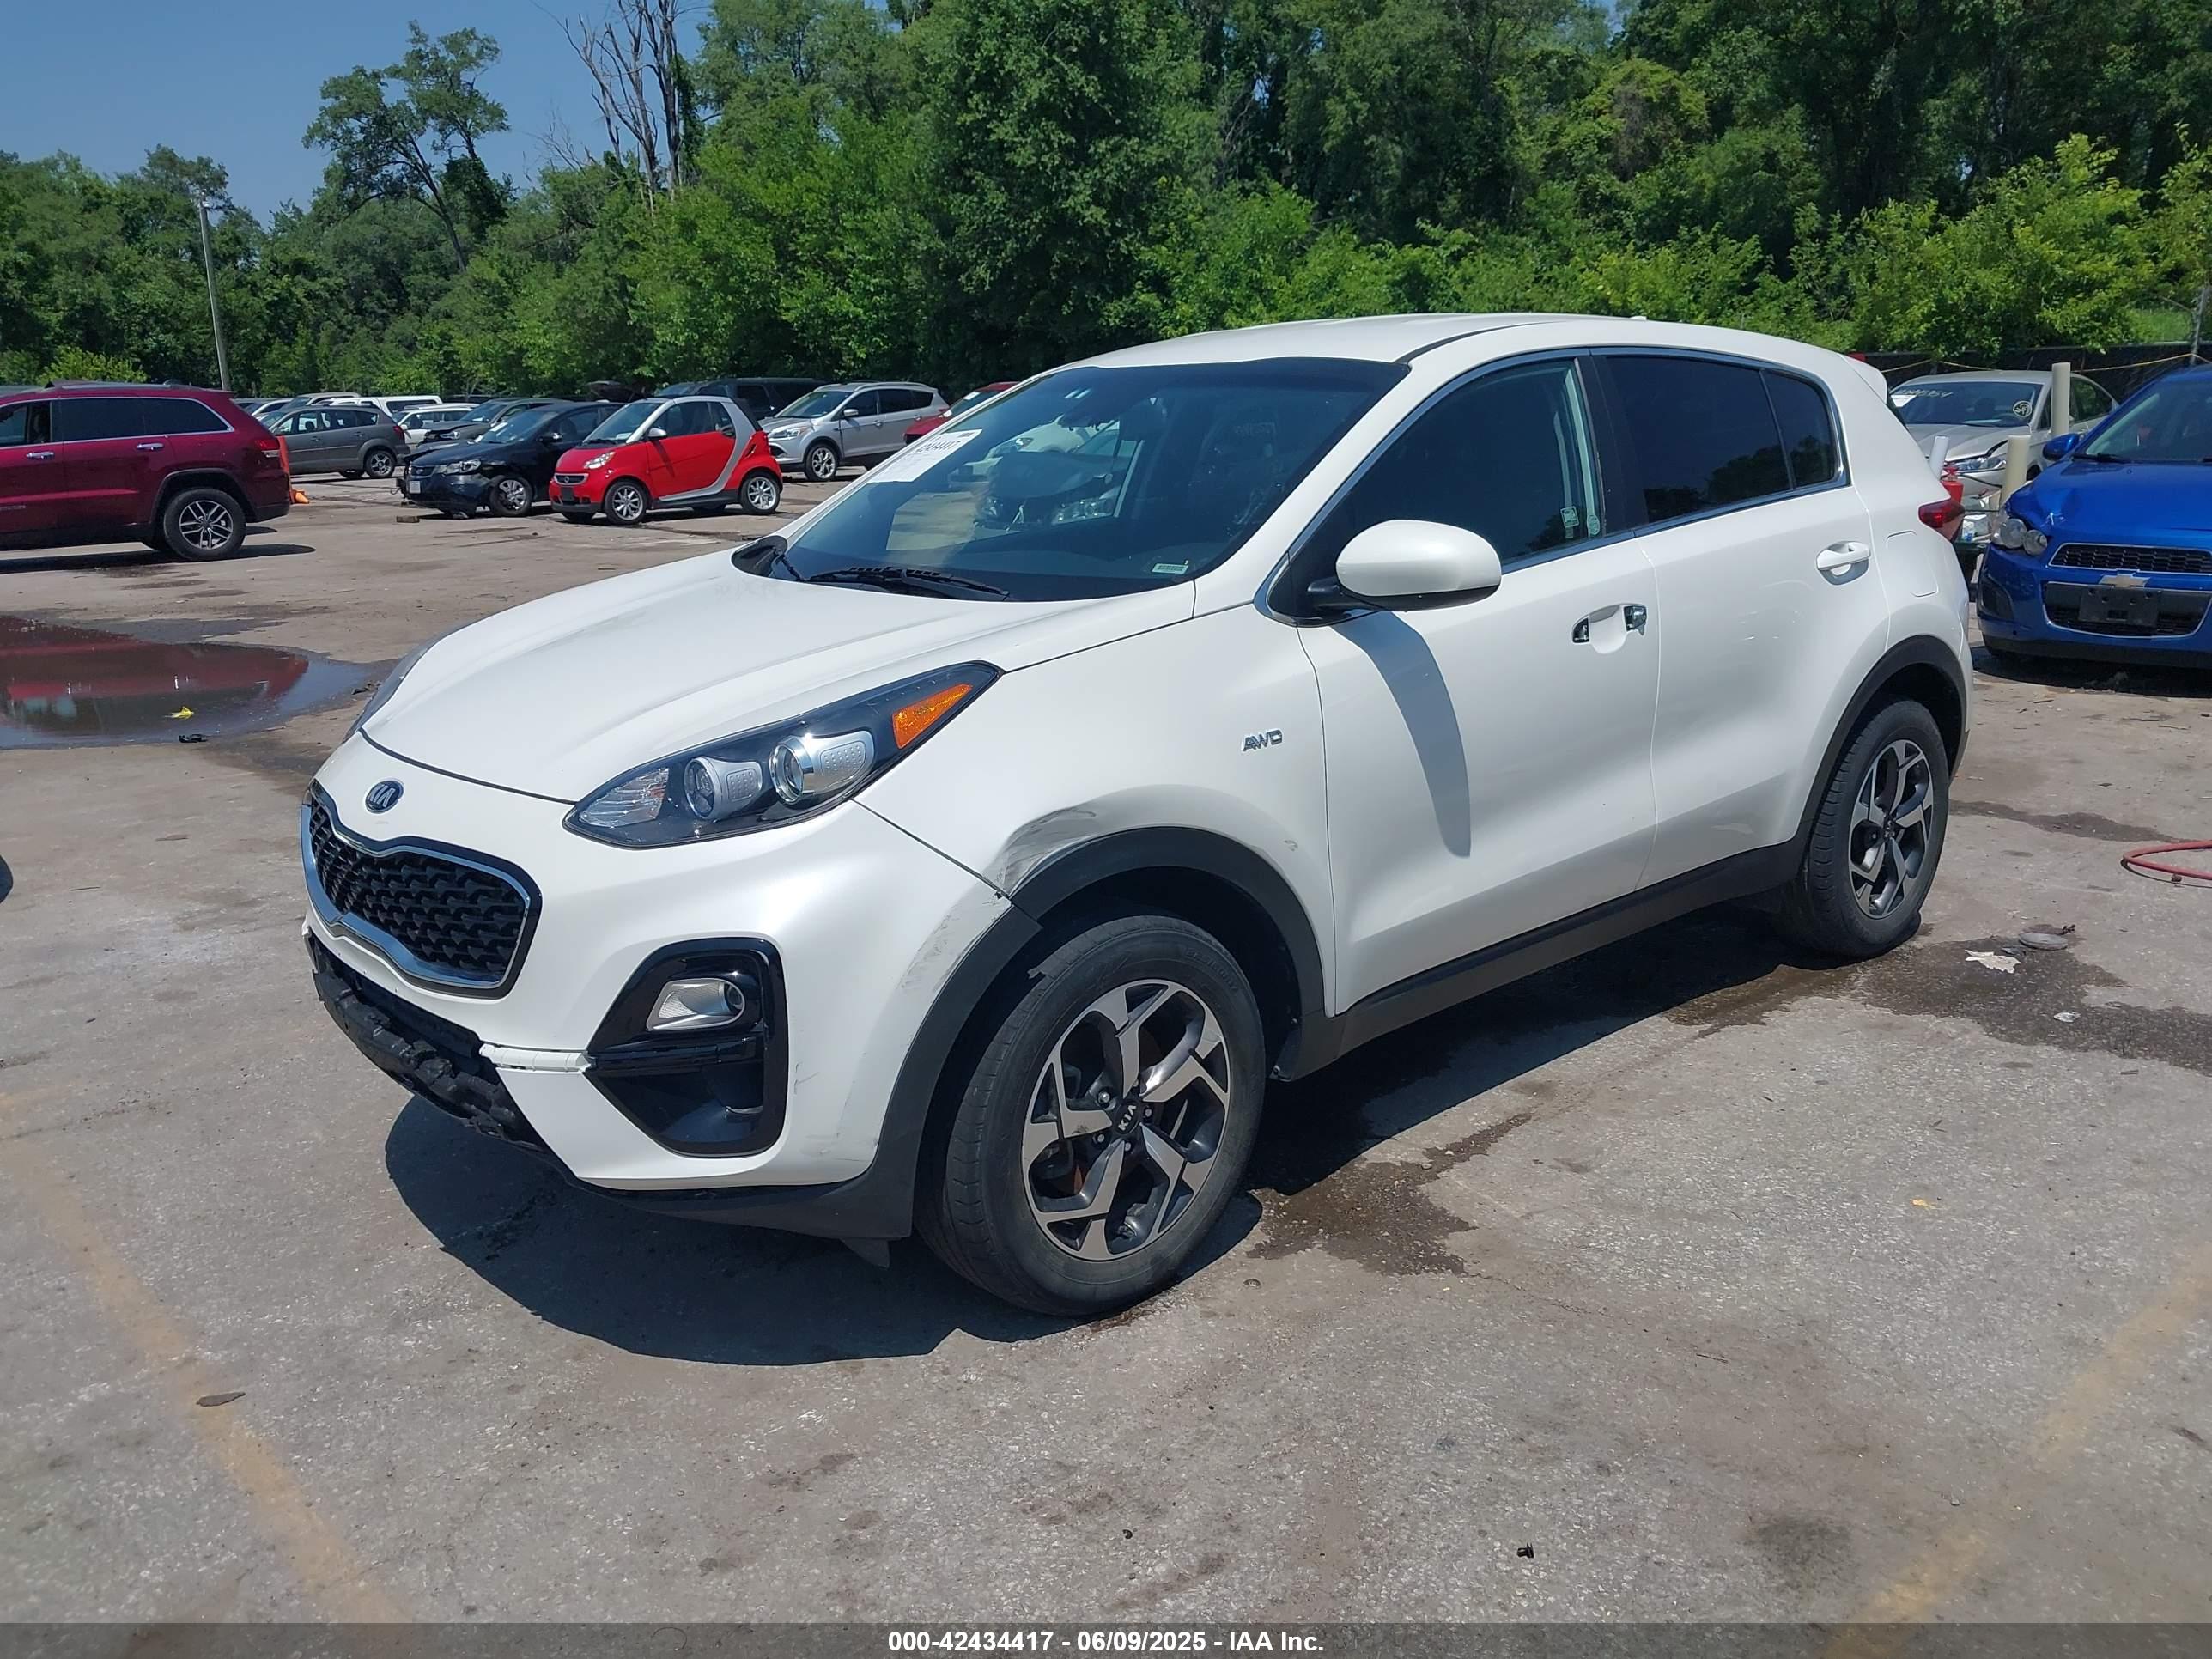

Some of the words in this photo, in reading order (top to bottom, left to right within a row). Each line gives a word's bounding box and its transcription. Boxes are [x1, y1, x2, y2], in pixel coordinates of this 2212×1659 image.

[1243, 729, 1283, 751] AWD
[367, 784, 396, 808] KIA
[1118, 1104, 1137, 1131] KIA
